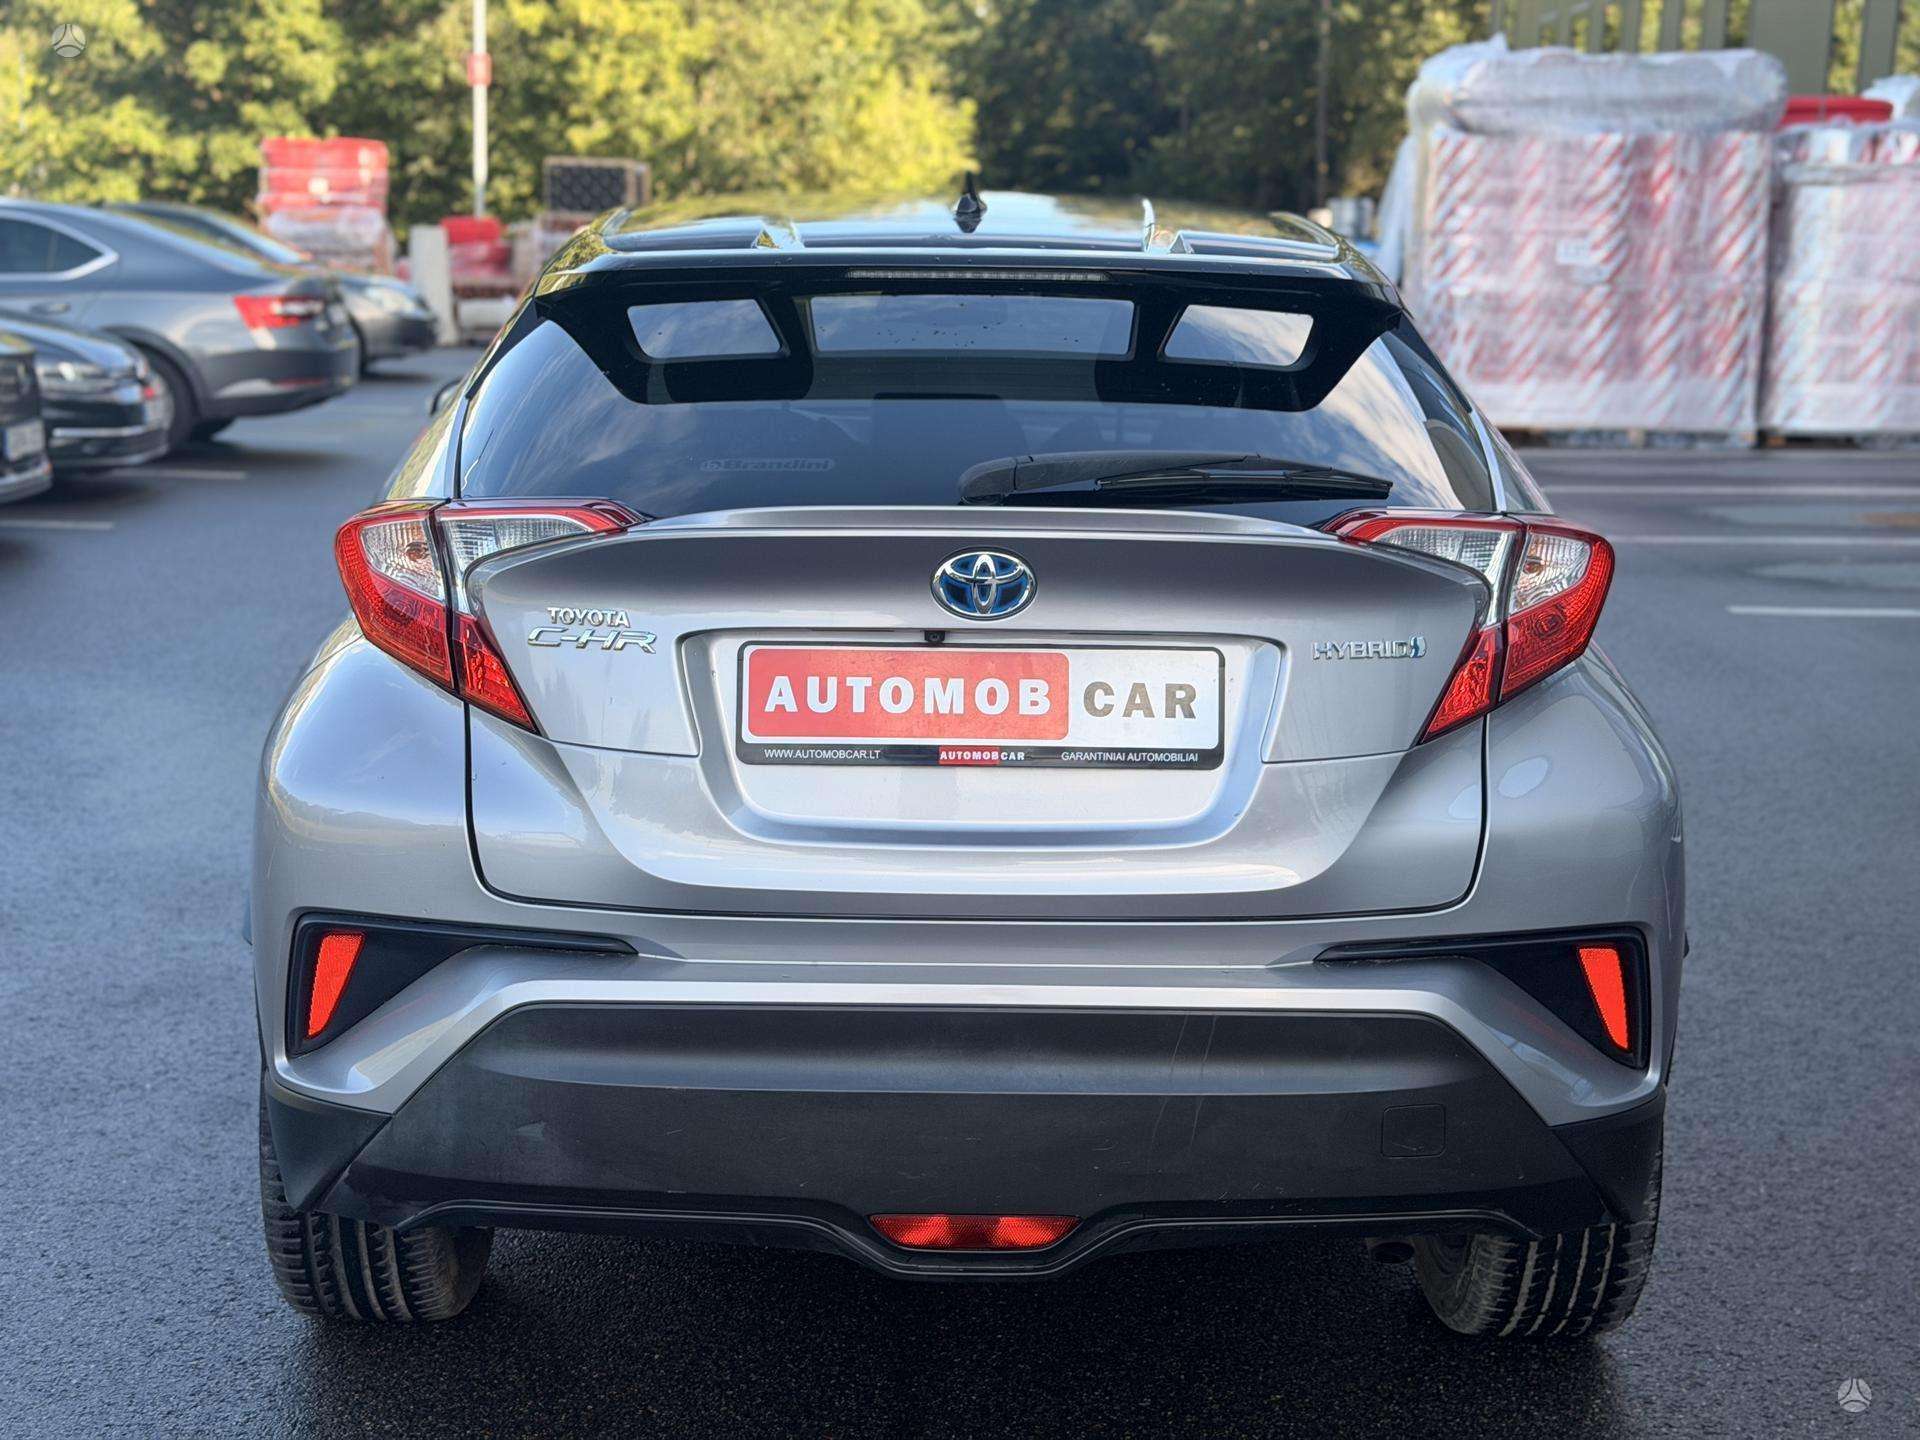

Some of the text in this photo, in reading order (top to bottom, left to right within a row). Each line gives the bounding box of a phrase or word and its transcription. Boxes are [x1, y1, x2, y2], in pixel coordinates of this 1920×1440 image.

[547, 606, 631, 629] TOYOTA
[527, 626, 658, 654] C-HR
[1312, 640, 1410, 660] HYBRID
[764, 676, 1197, 718] AUTOMOB CAR
[764, 748, 881, 761] WWW.AUTOMOBCAR.LT
[1061, 751, 1199, 764] GARANTINIAI AUTOMOBILIAI
